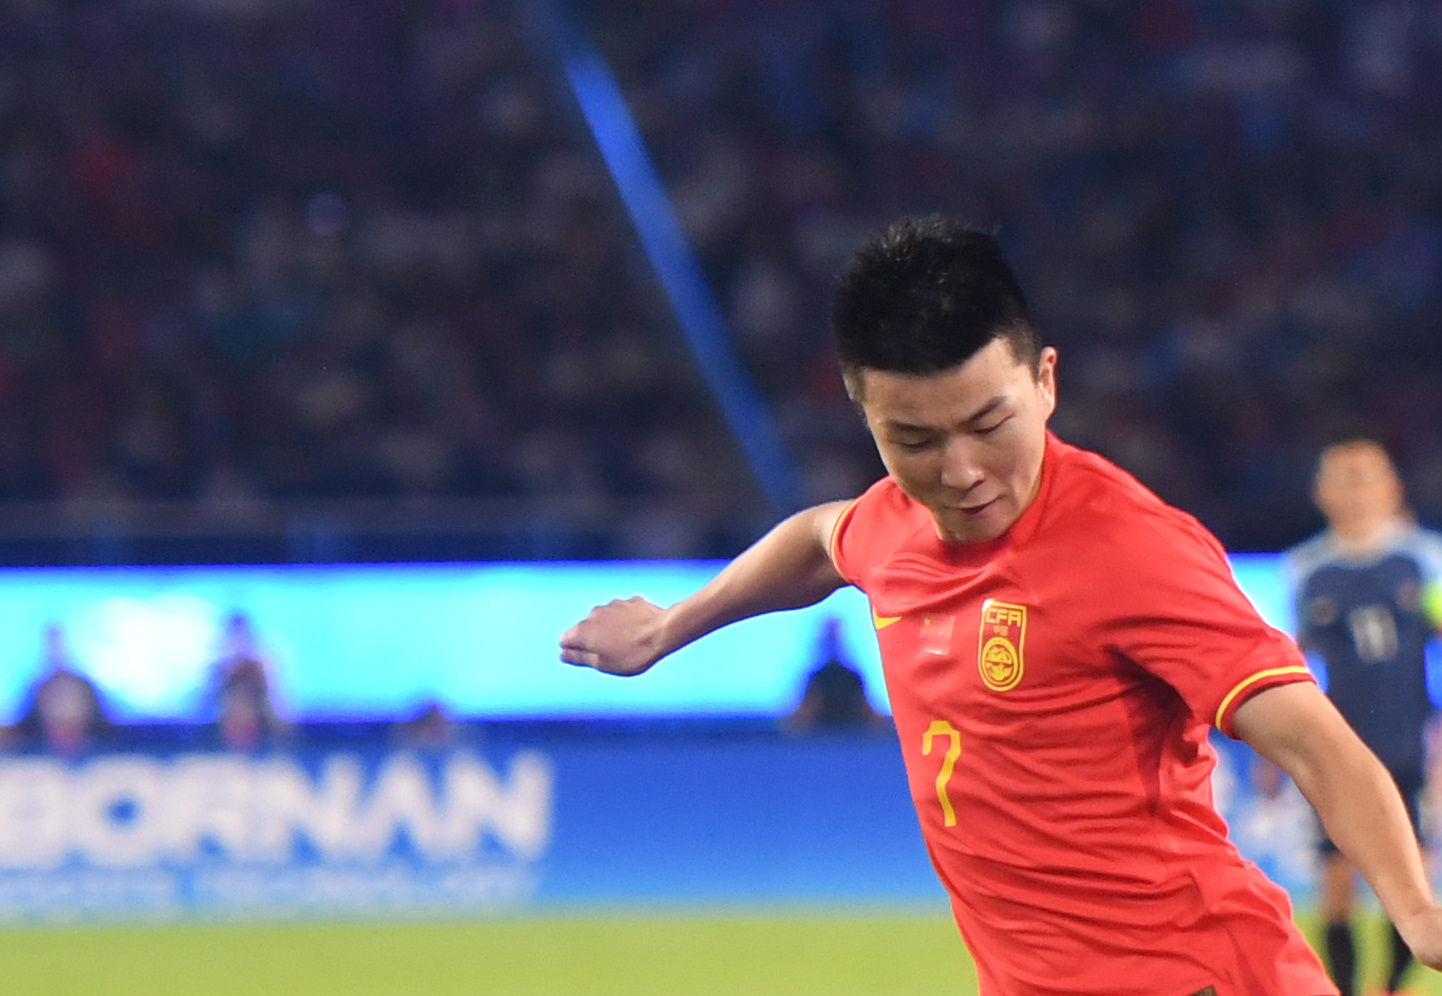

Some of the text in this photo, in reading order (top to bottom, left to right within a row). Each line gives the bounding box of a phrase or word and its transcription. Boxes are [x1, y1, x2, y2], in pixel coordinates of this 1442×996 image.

[985, 607, 1022, 628] CFA
[0, 750, 553, 868] BORNAN
[921, 719, 962, 828] 7
